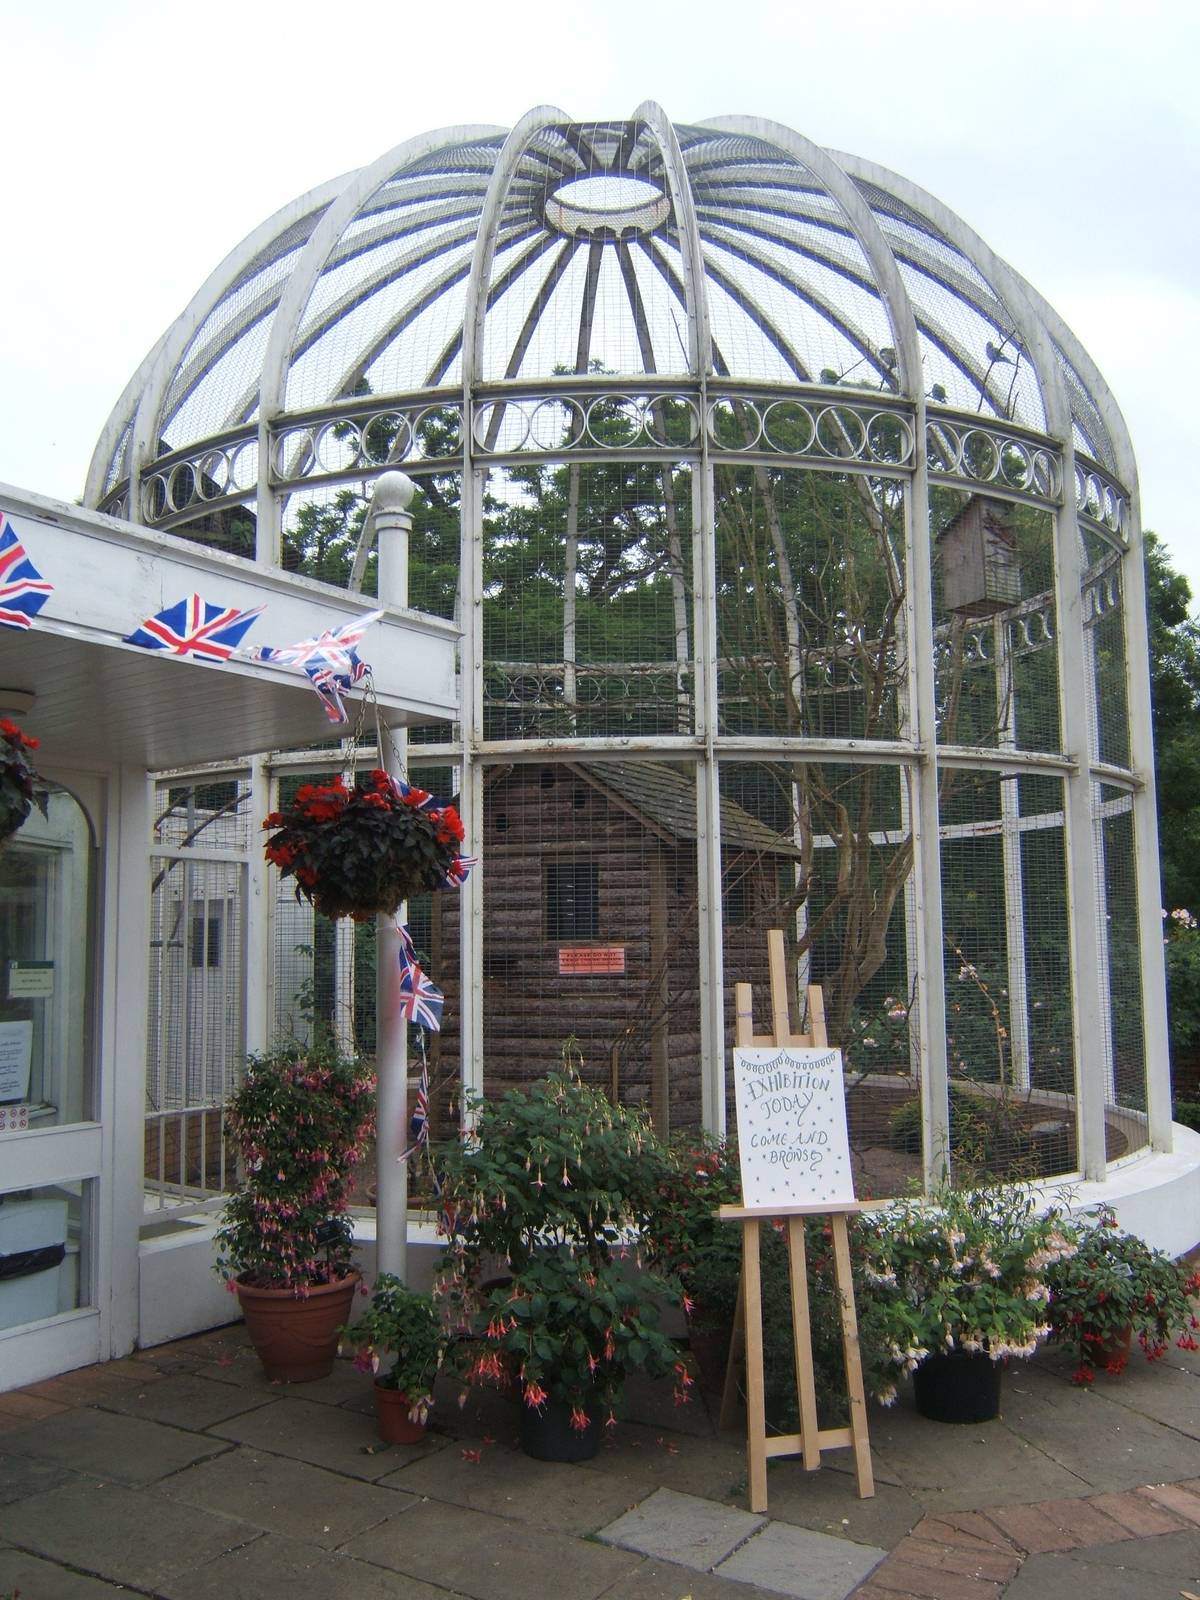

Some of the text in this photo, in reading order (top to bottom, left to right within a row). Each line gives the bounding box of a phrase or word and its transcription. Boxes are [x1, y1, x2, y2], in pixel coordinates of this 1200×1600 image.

[746, 1071, 830, 1101] EXHIBITION
[761, 1091, 814, 1127] TODAY
[750, 1130, 829, 1148] COME AND
[769, 1148, 823, 1172] BROWSE
